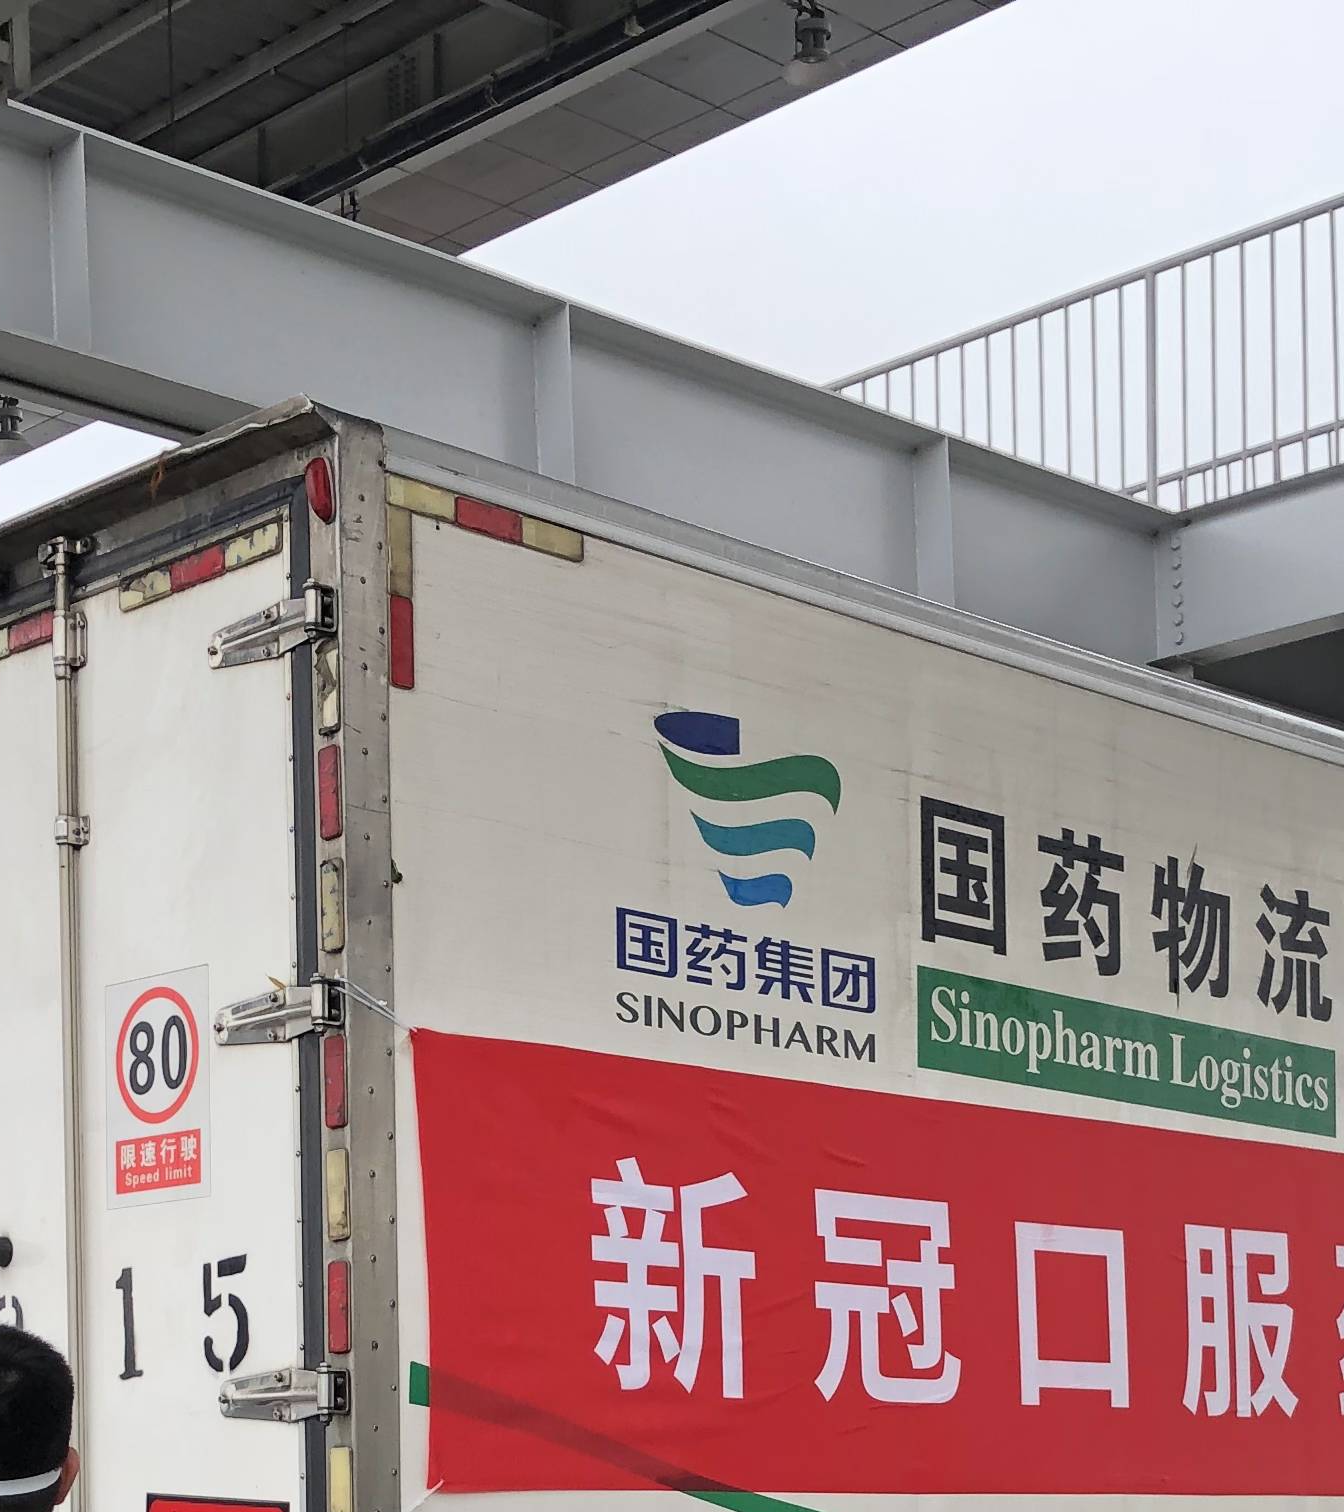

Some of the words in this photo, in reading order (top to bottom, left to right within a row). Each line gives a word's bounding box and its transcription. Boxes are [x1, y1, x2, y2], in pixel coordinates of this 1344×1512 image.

[920, 796, 1333, 1022] 国药物流
[616, 907, 876, 1013] 国药集团
[129, 1015, 188, 1095] 80
[616, 991, 876, 1062] SINOPHARM
[930, 986, 1160, 1082] Sinopharm
[1169, 1032, 1329, 1111] Logistics
[120, 1135, 198, 1170] 限速行驶
[125, 1168, 160, 1188] Speed
[165, 1164, 193, 1181] limit
